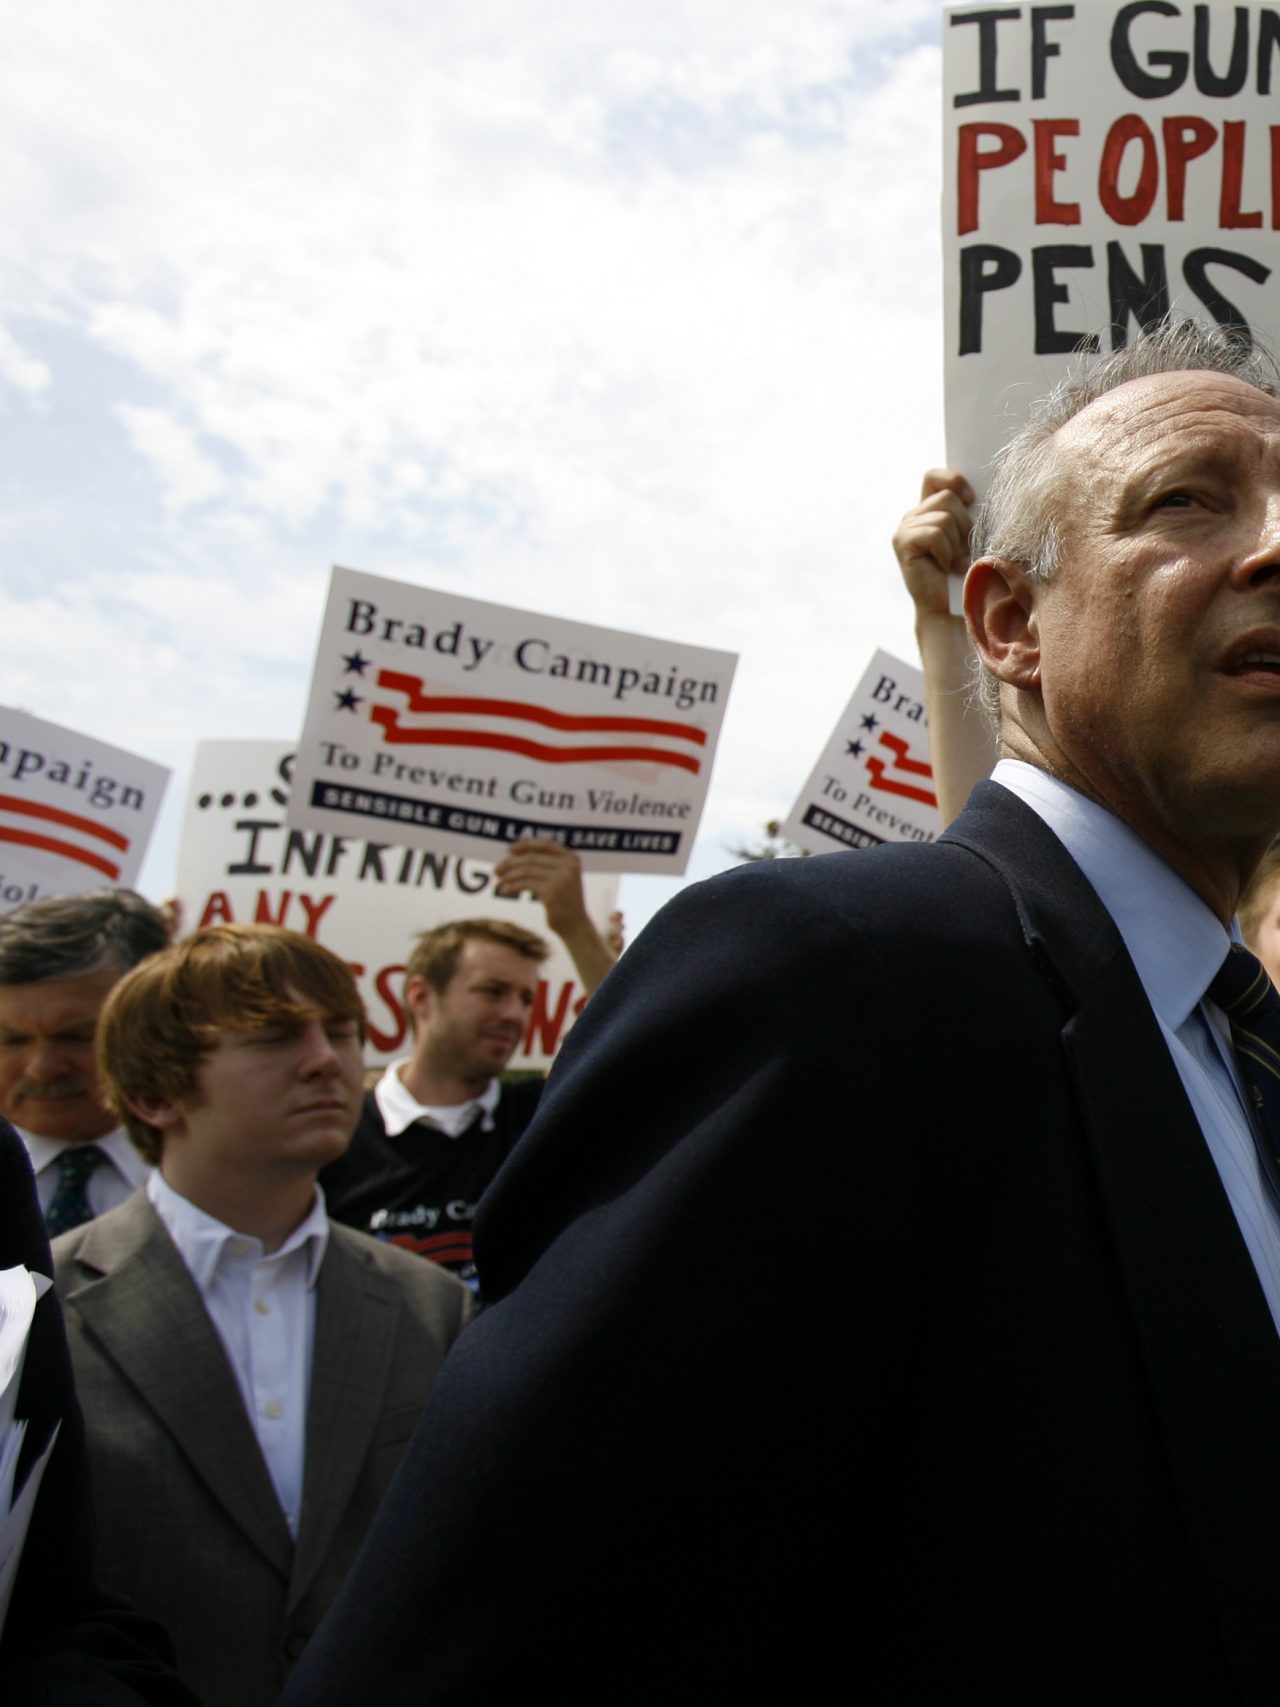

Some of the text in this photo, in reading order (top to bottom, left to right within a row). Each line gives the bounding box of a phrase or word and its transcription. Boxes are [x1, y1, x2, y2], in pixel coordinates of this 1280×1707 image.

[949, 4, 1074, 108] IF
[958, 240, 1272, 356] PENS
[345, 599, 720, 711] Brady Campaign
[871, 673, 929, 729] Bra
[320, 741, 692, 820] To Prevent Gun Violence
[821, 775, 935, 842] To Prevent
[323, 788, 443, 826] SENSIBLE
[447, 811, 501, 837] GUN
[569, 831, 618, 849] SAVE
[621, 833, 674, 851] LIVES
[199, 890, 336, 942] ANY
